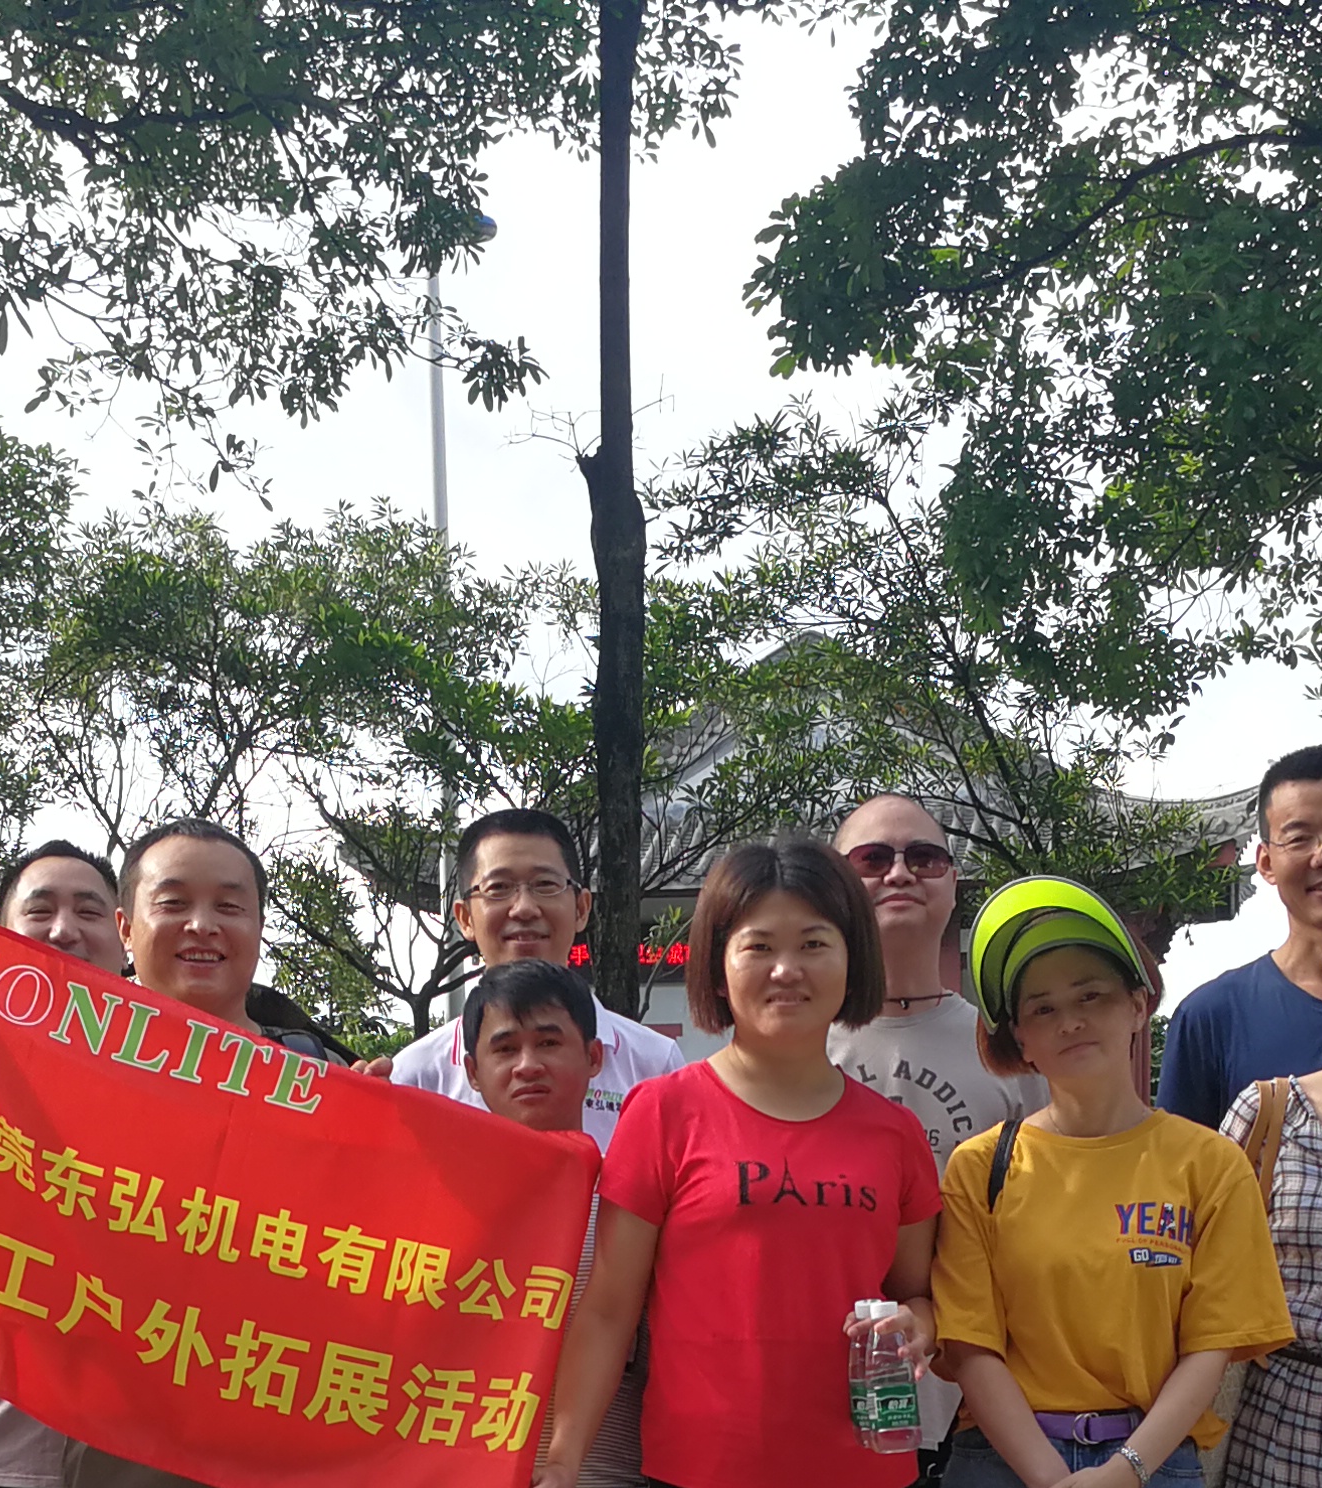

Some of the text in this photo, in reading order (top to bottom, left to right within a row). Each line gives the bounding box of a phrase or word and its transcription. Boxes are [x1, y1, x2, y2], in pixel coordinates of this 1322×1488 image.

[893, 1059, 973, 1148] ADDIC
[1115, 1202, 1194, 1249] YEAH
[1133, 1248, 1150, 1262] GO
